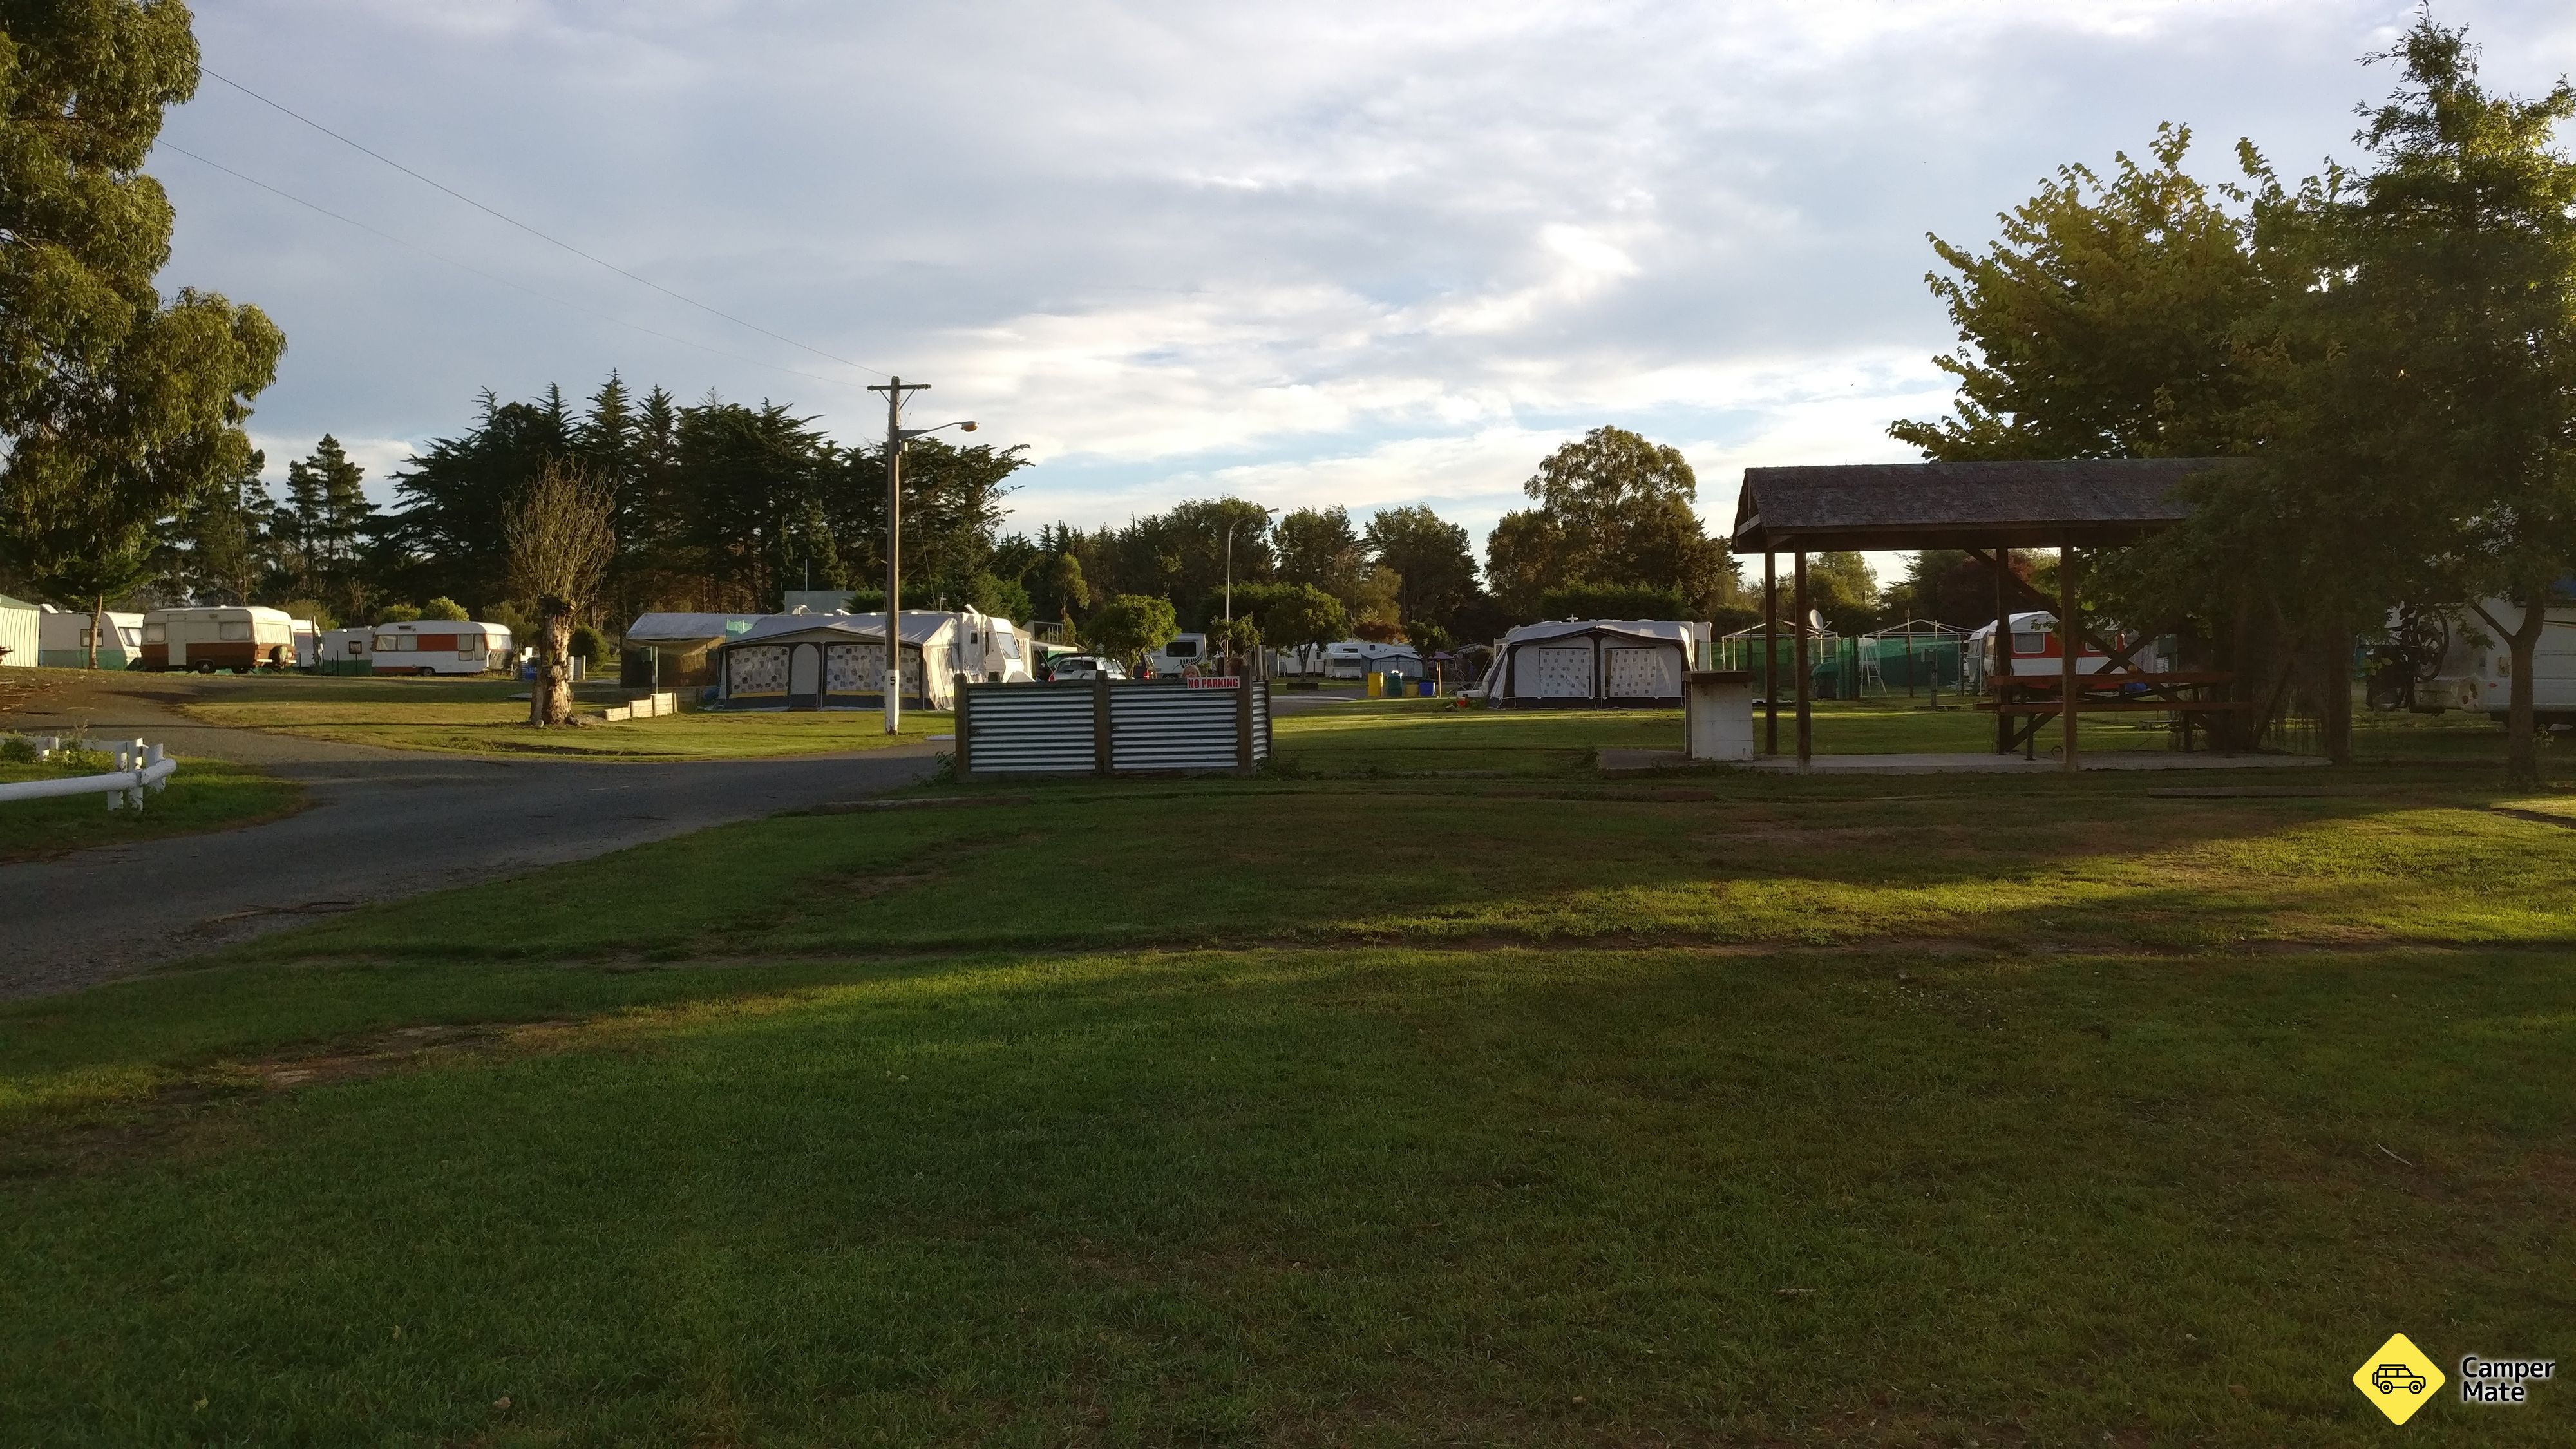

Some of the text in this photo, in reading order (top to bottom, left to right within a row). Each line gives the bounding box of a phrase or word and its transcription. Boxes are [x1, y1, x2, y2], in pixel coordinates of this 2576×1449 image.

[890, 676, 896, 685] 5
[1188, 678, 1238, 688] NO PARKING
